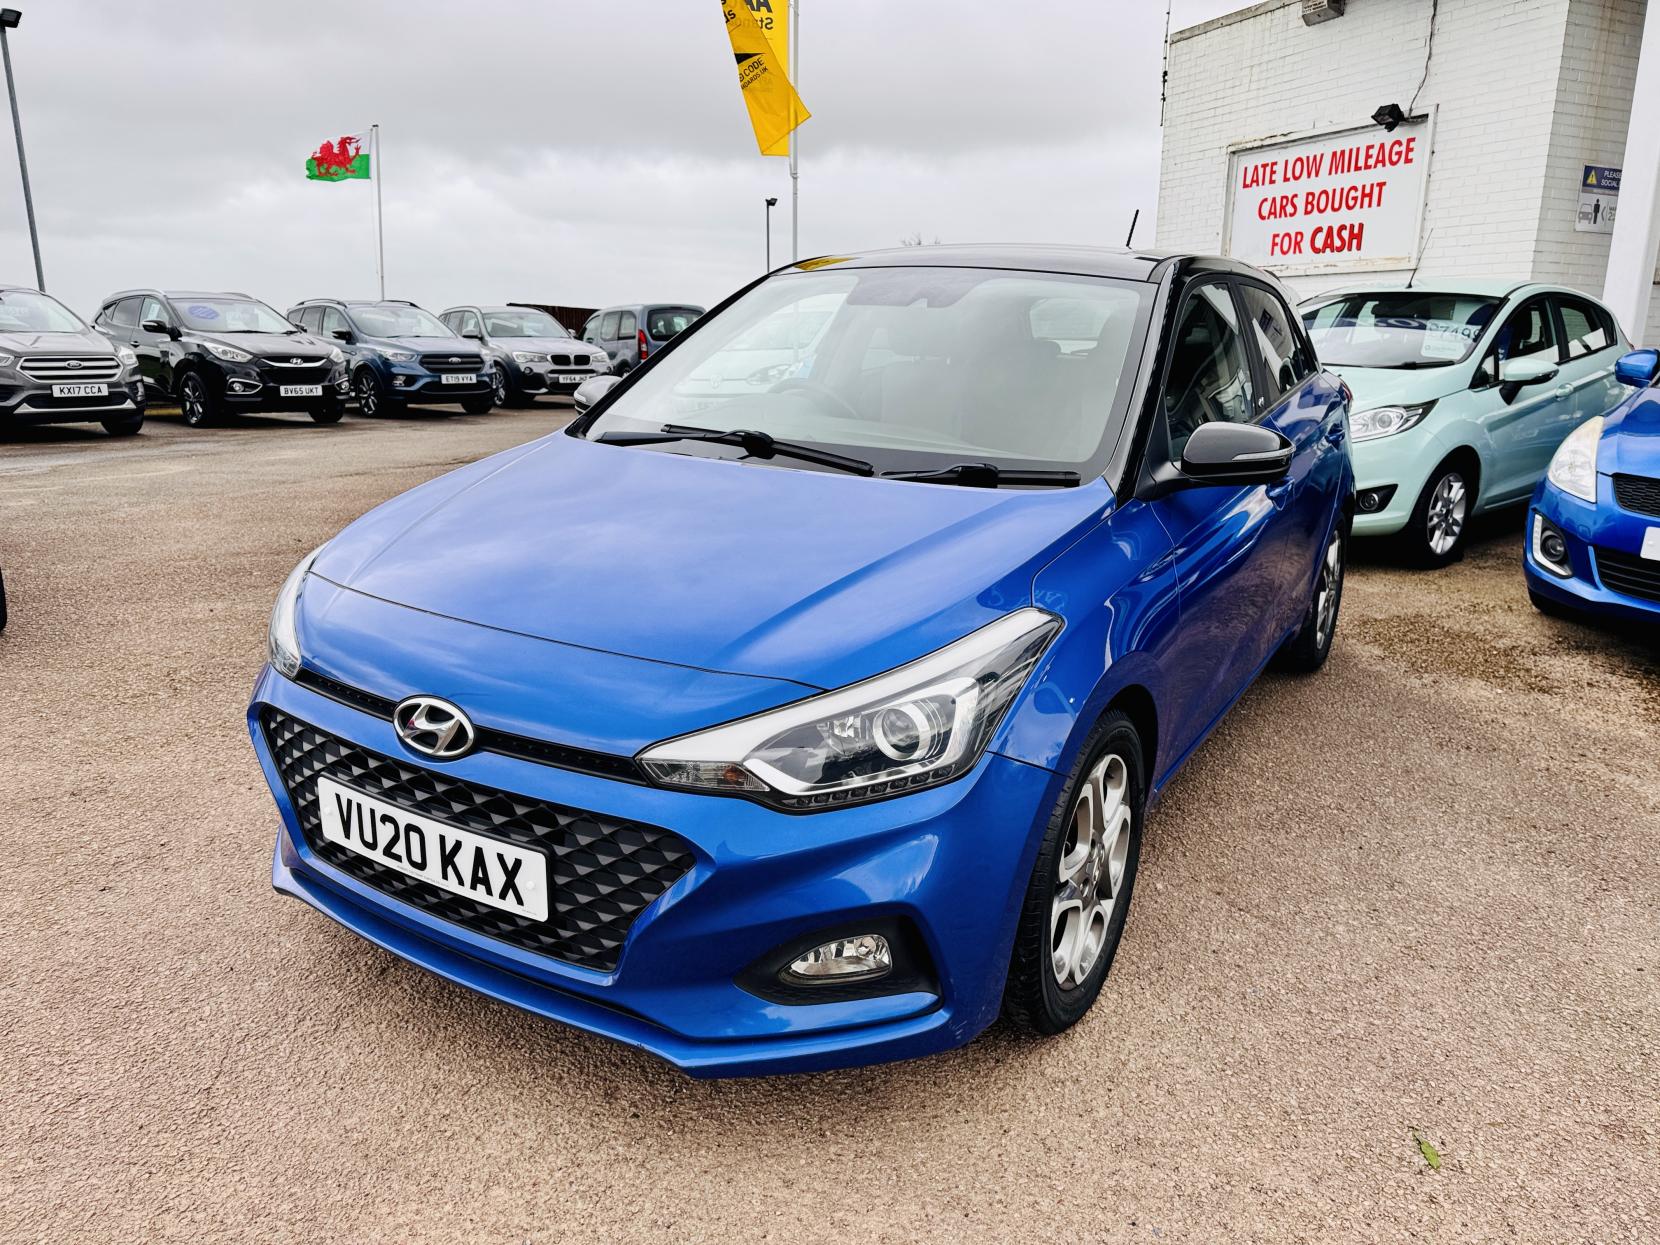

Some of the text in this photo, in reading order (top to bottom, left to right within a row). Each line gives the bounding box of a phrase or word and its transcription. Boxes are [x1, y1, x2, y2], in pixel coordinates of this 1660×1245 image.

[743, 56, 765, 77] CODE
[1242, 136, 1416, 189] LATE LOW MILEAGE
[1257, 181, 1387, 221] CARS BOUGHT
[1270, 222, 1364, 256] FOR CASH
[59, 385, 103, 395] KX17 CCA
[283, 386, 319, 395] BV65 UKT
[335, 792, 524, 906] VU20 KAX
